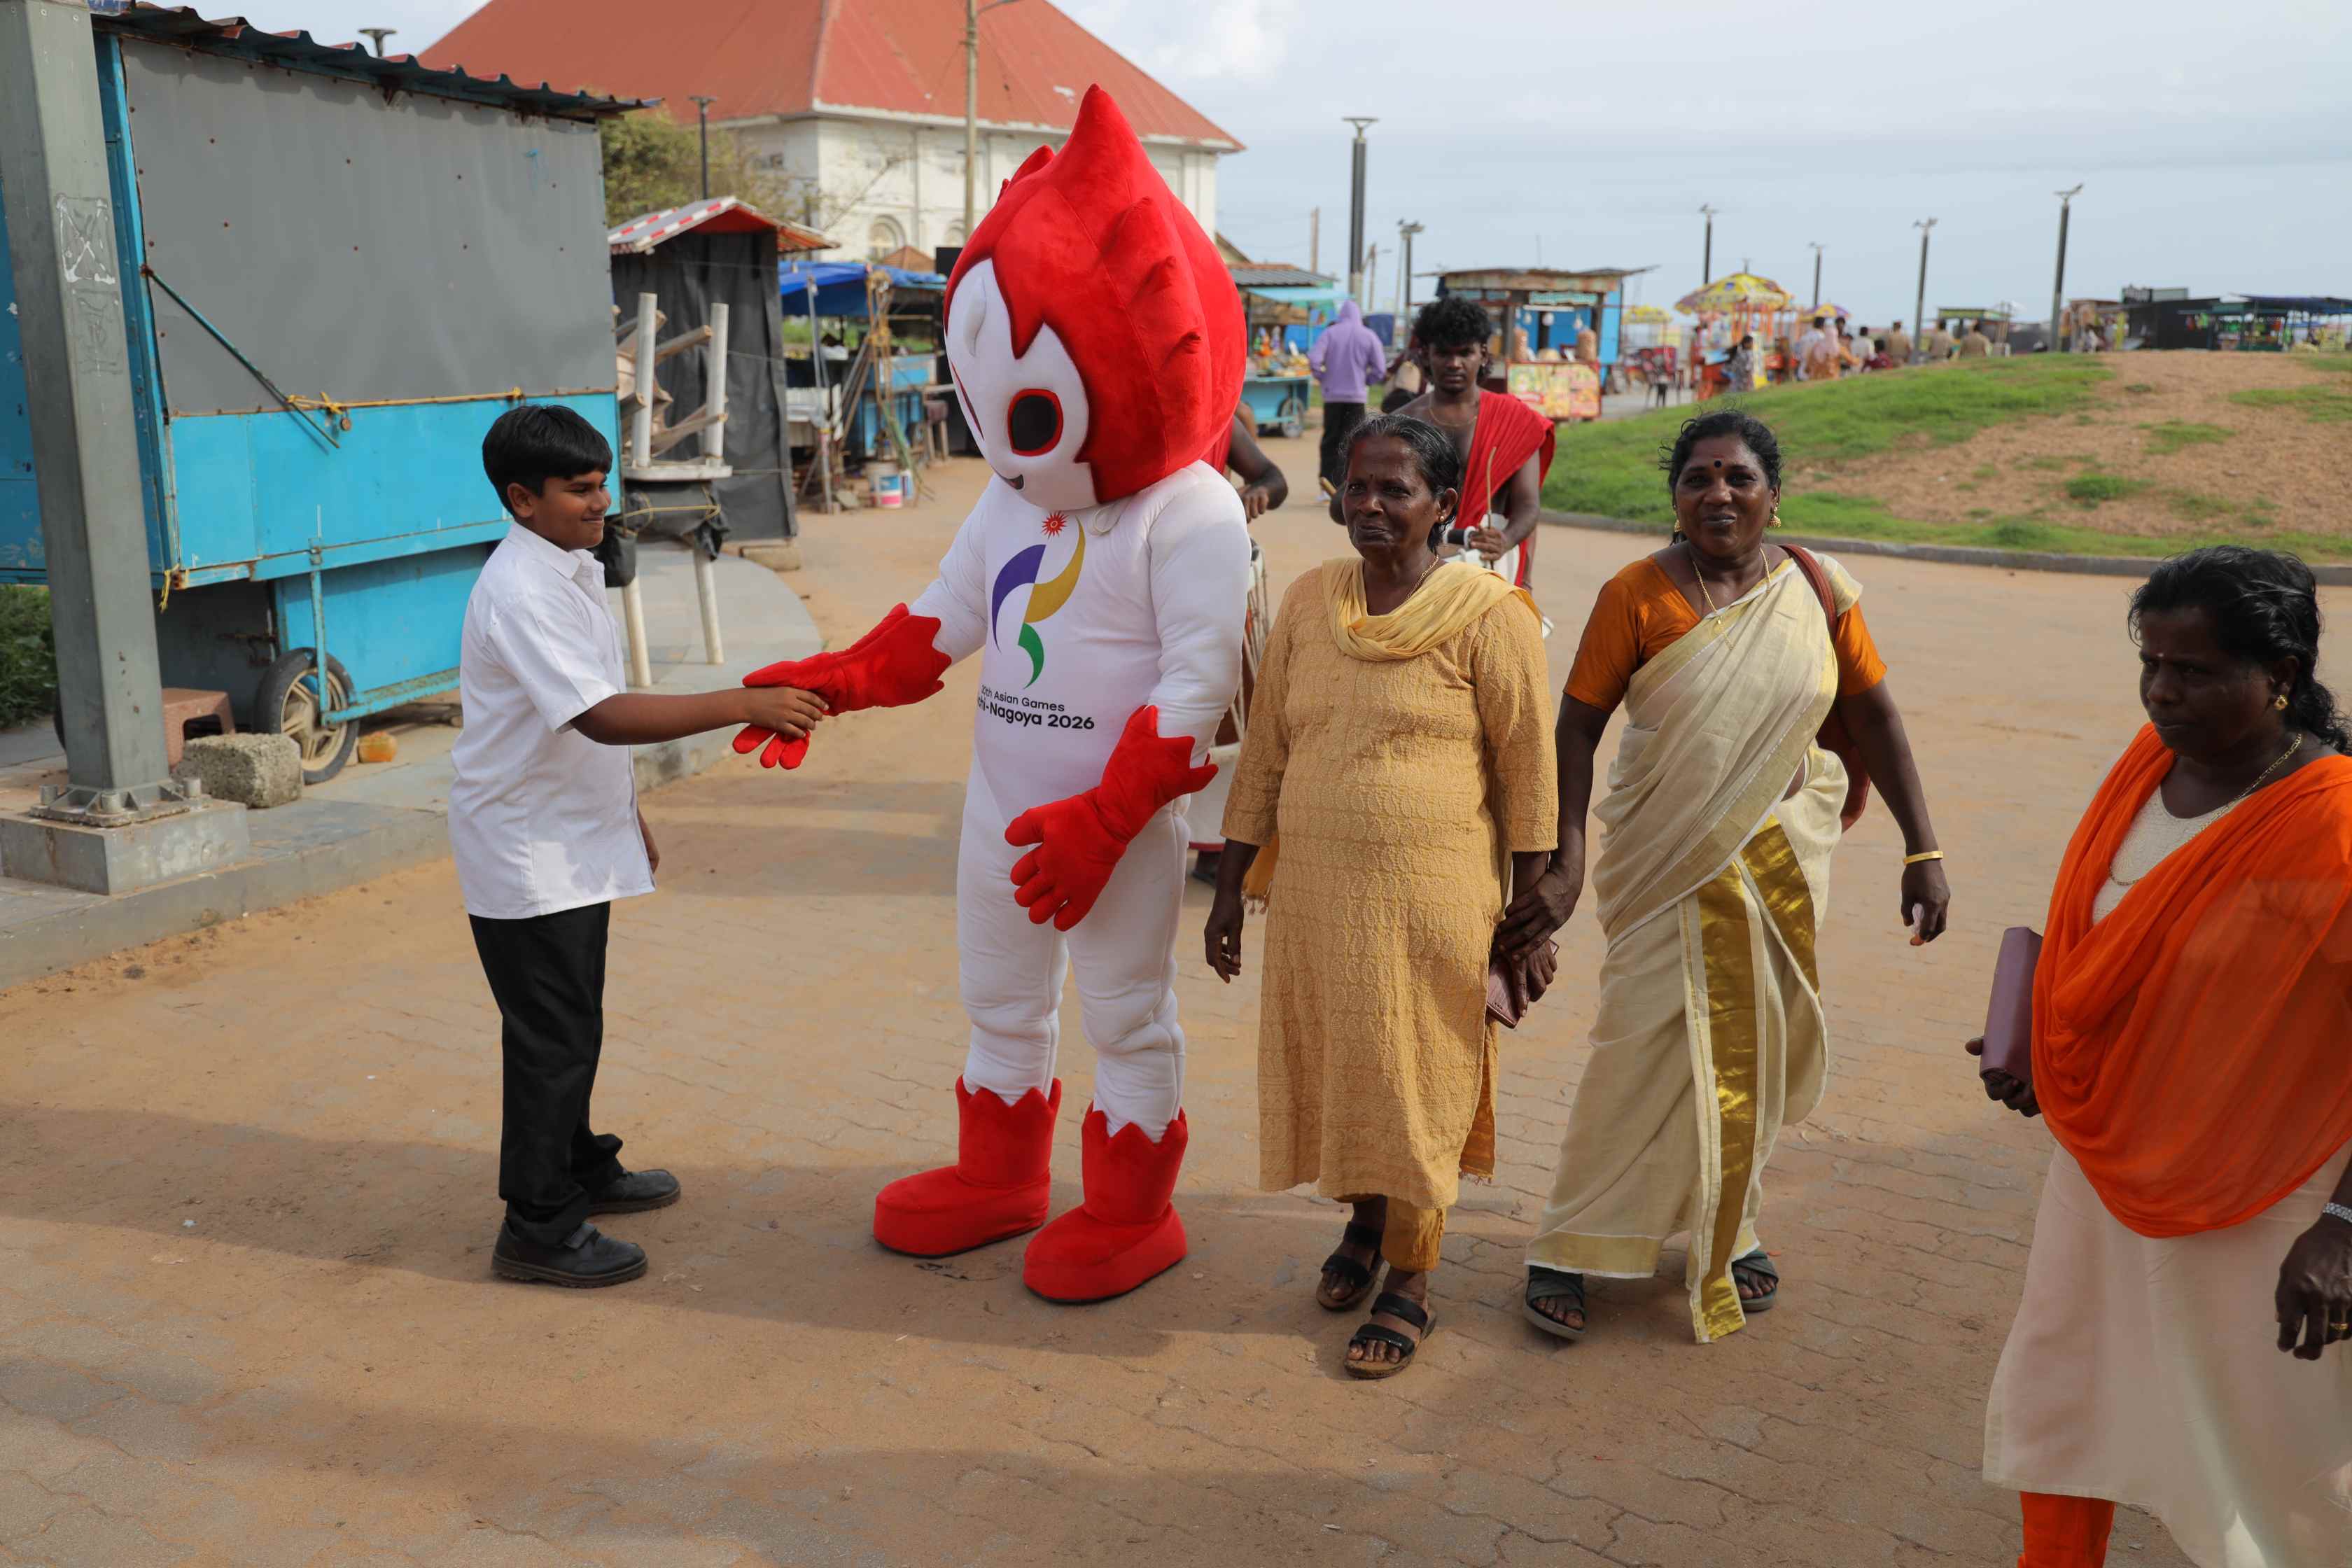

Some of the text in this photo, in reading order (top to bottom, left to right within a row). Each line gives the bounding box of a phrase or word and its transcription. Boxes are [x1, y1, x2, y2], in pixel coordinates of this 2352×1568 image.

[994, 691, 1019, 705] Asian
[1021, 697, 1065, 712] Games
[1047, 714, 1095, 729] 2026
